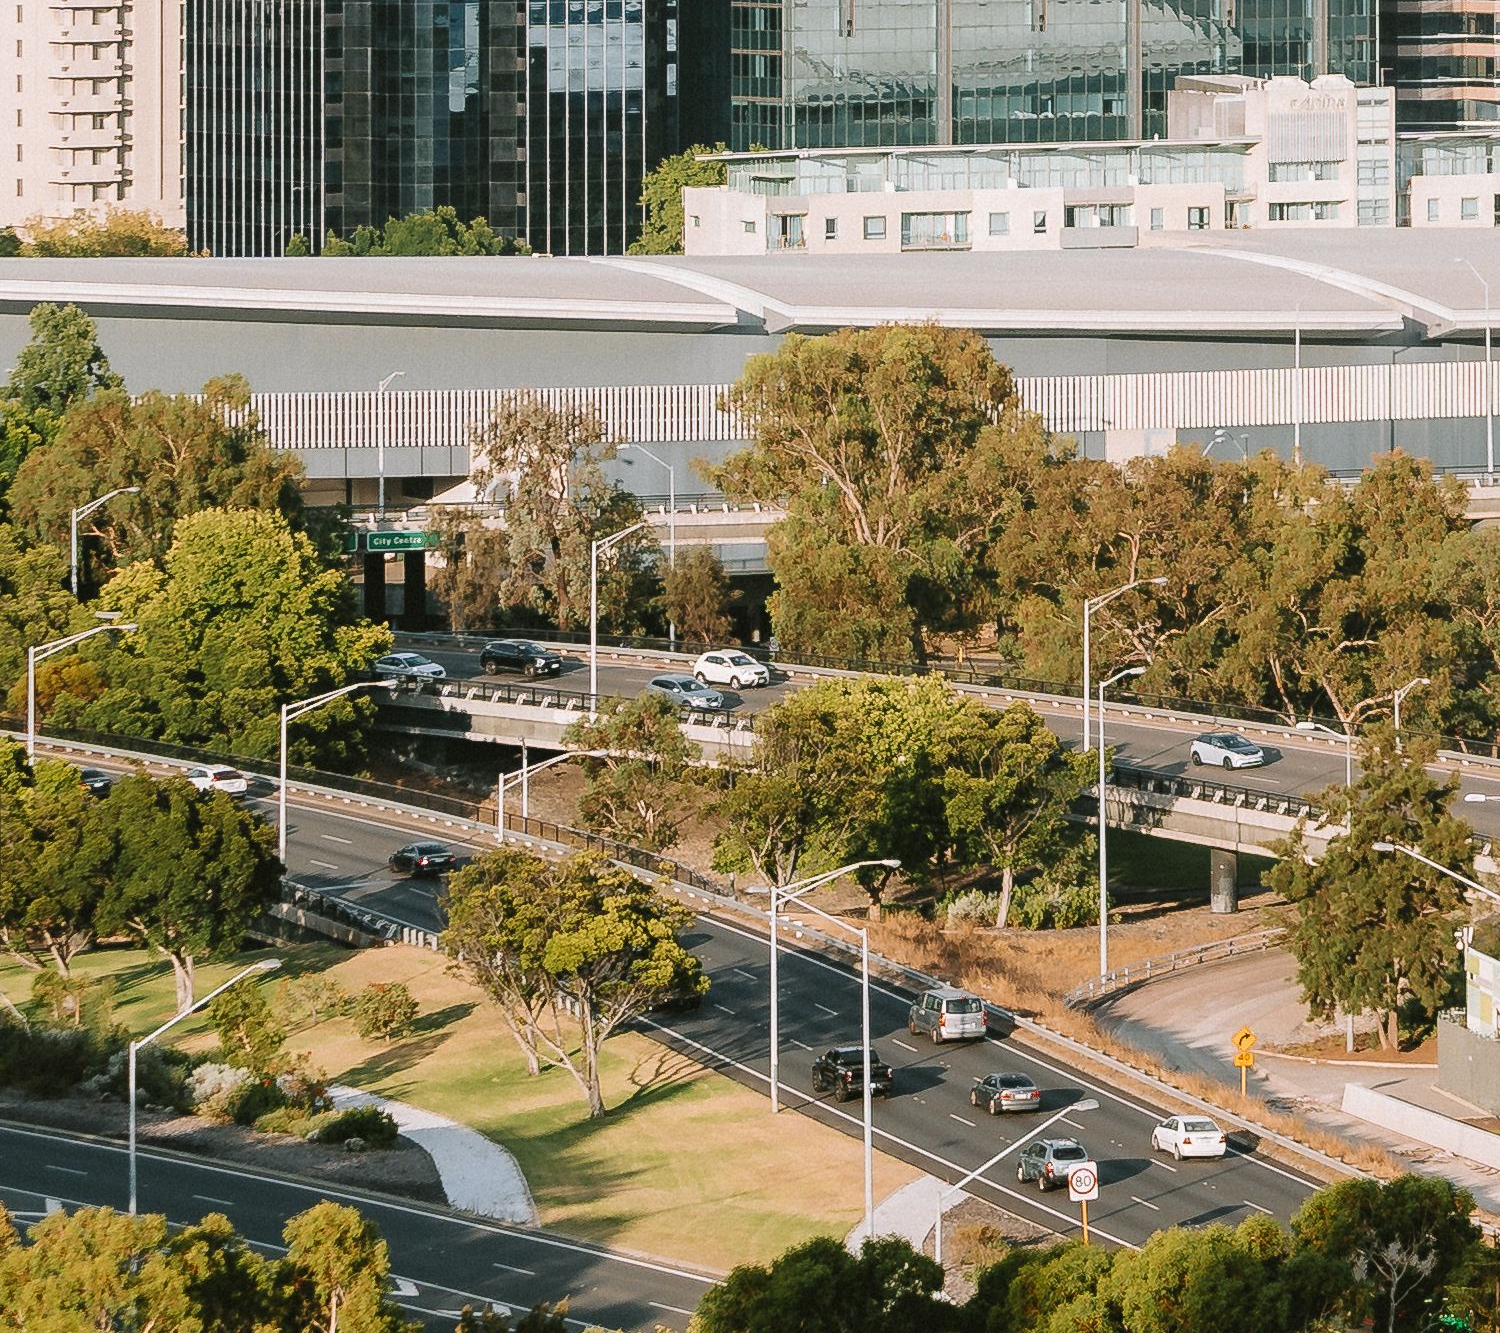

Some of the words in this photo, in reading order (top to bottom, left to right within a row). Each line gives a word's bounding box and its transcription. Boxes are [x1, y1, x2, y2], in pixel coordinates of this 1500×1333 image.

[373, 537, 392, 546] City
[1238, 1053, 1251, 1061] 40
[1075, 1175, 1092, 1187] 80
